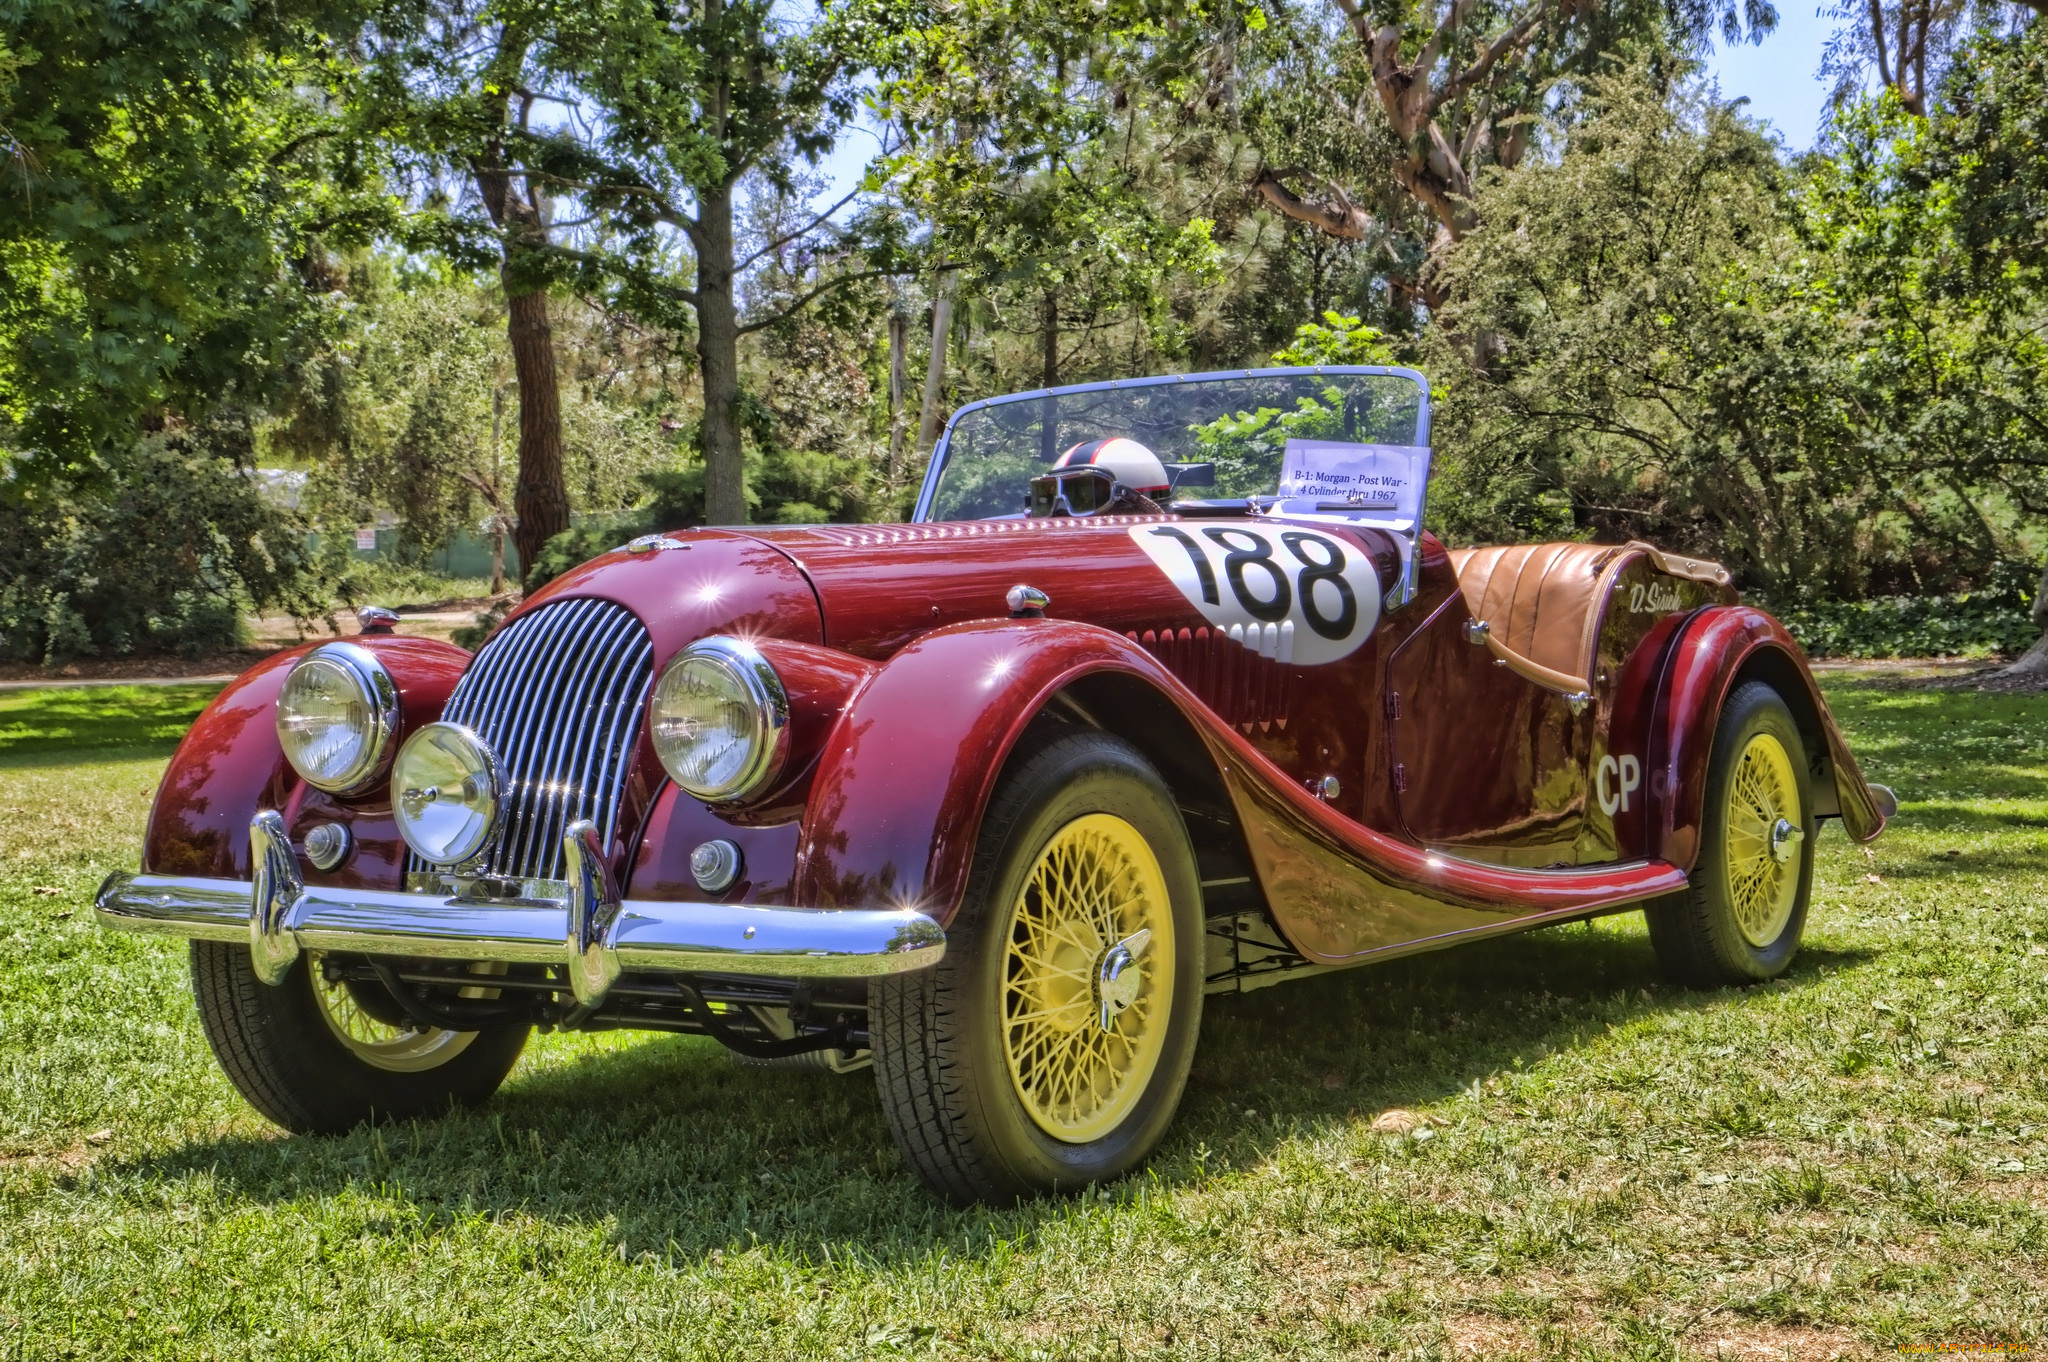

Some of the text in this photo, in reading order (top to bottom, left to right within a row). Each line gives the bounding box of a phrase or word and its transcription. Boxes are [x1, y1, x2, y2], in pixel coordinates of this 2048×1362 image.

[1294, 470, 1314, 481] B-1:
[1315, 471, 1350, 485] Morgan
[1358, 474, 1379, 486] Post
[1381, 476, 1402, 487] War
[1300, 485, 1307, 495] 4
[1347, 487, 1369, 499] thru
[1371, 489, 1396, 501] 1967
[1147, 526, 1357, 641] 188
[1597, 754, 1640, 816] CP
